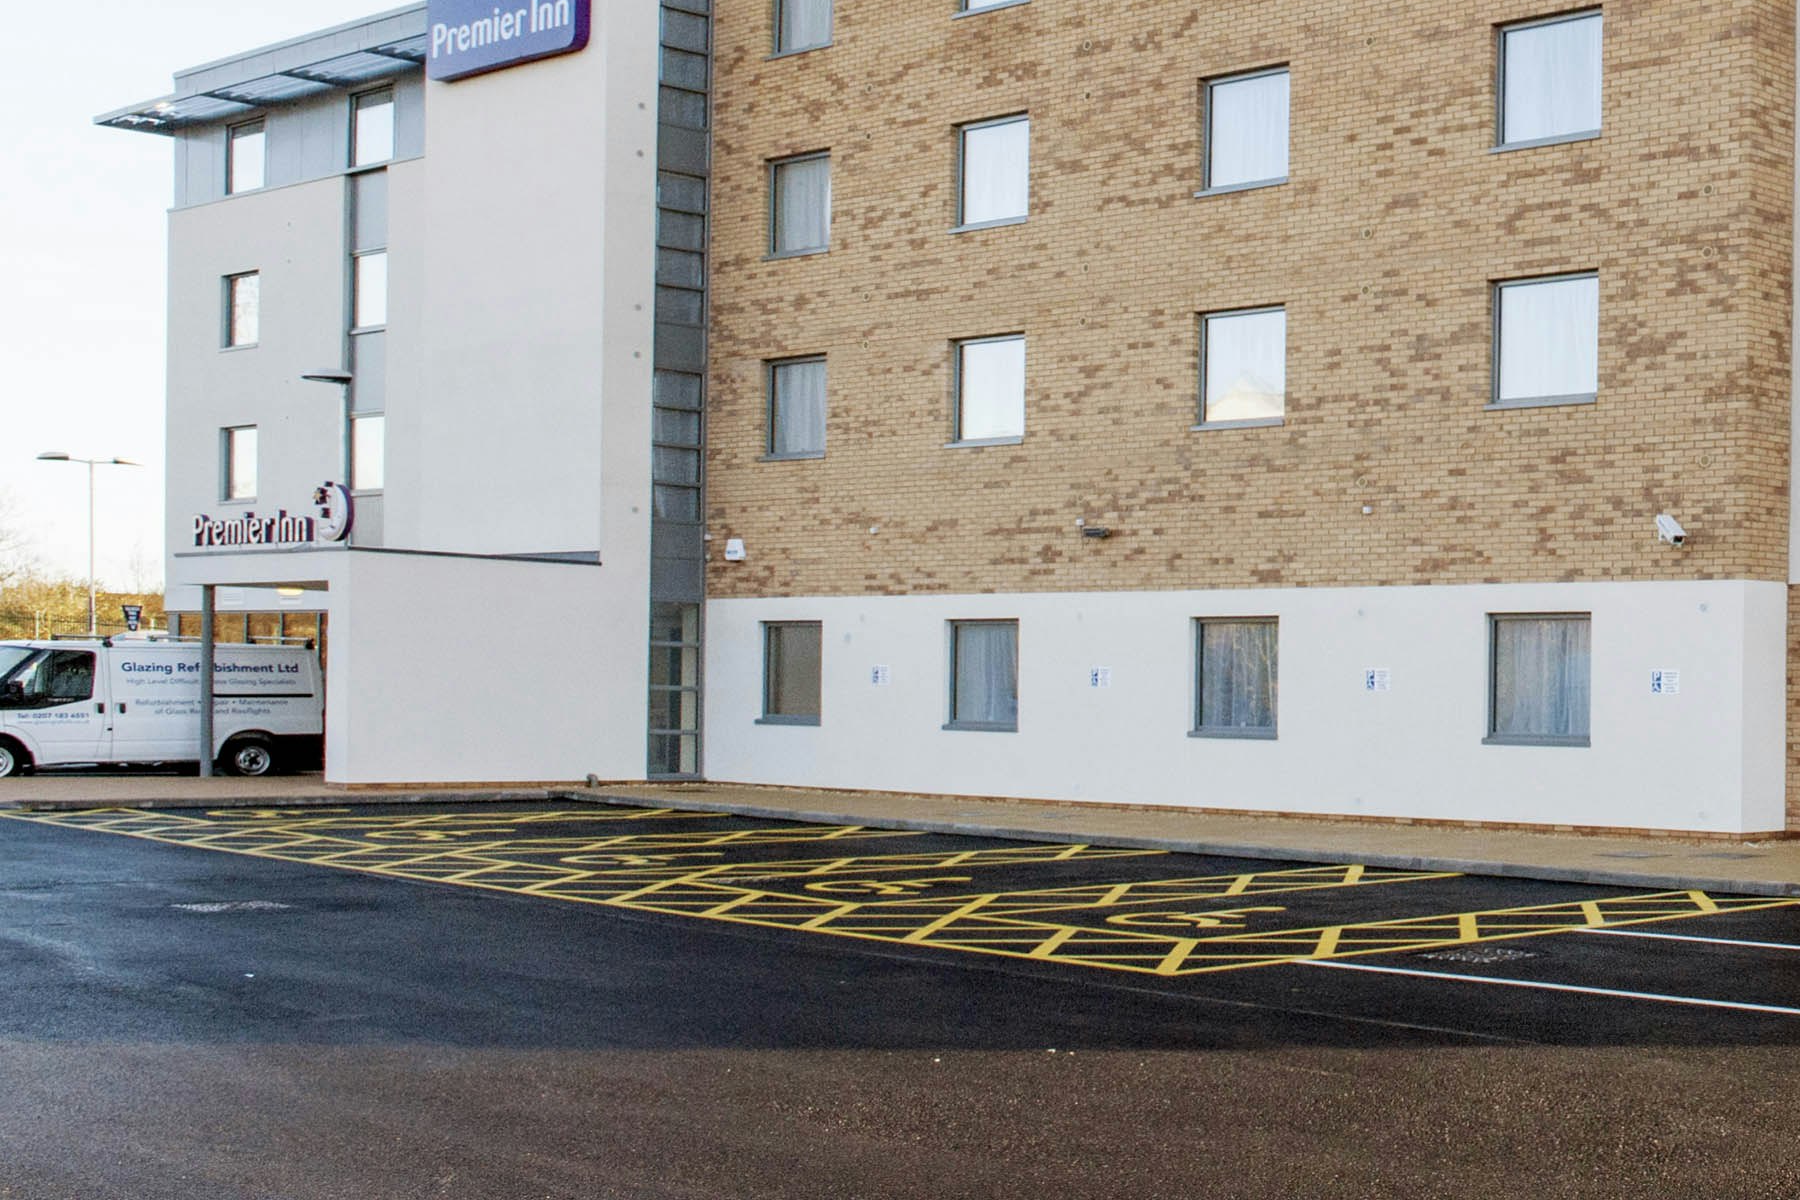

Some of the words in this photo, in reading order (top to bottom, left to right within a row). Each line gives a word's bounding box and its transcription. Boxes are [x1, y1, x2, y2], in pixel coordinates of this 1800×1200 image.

[432, 7, 527, 58] Premier
[192, 511, 275, 546] Premier
[275, 508, 314, 543] Inn
[121, 662, 173, 674] Glazing
[177, 662, 274, 672] Refbishment
[278, 663, 299, 672] Ltd
